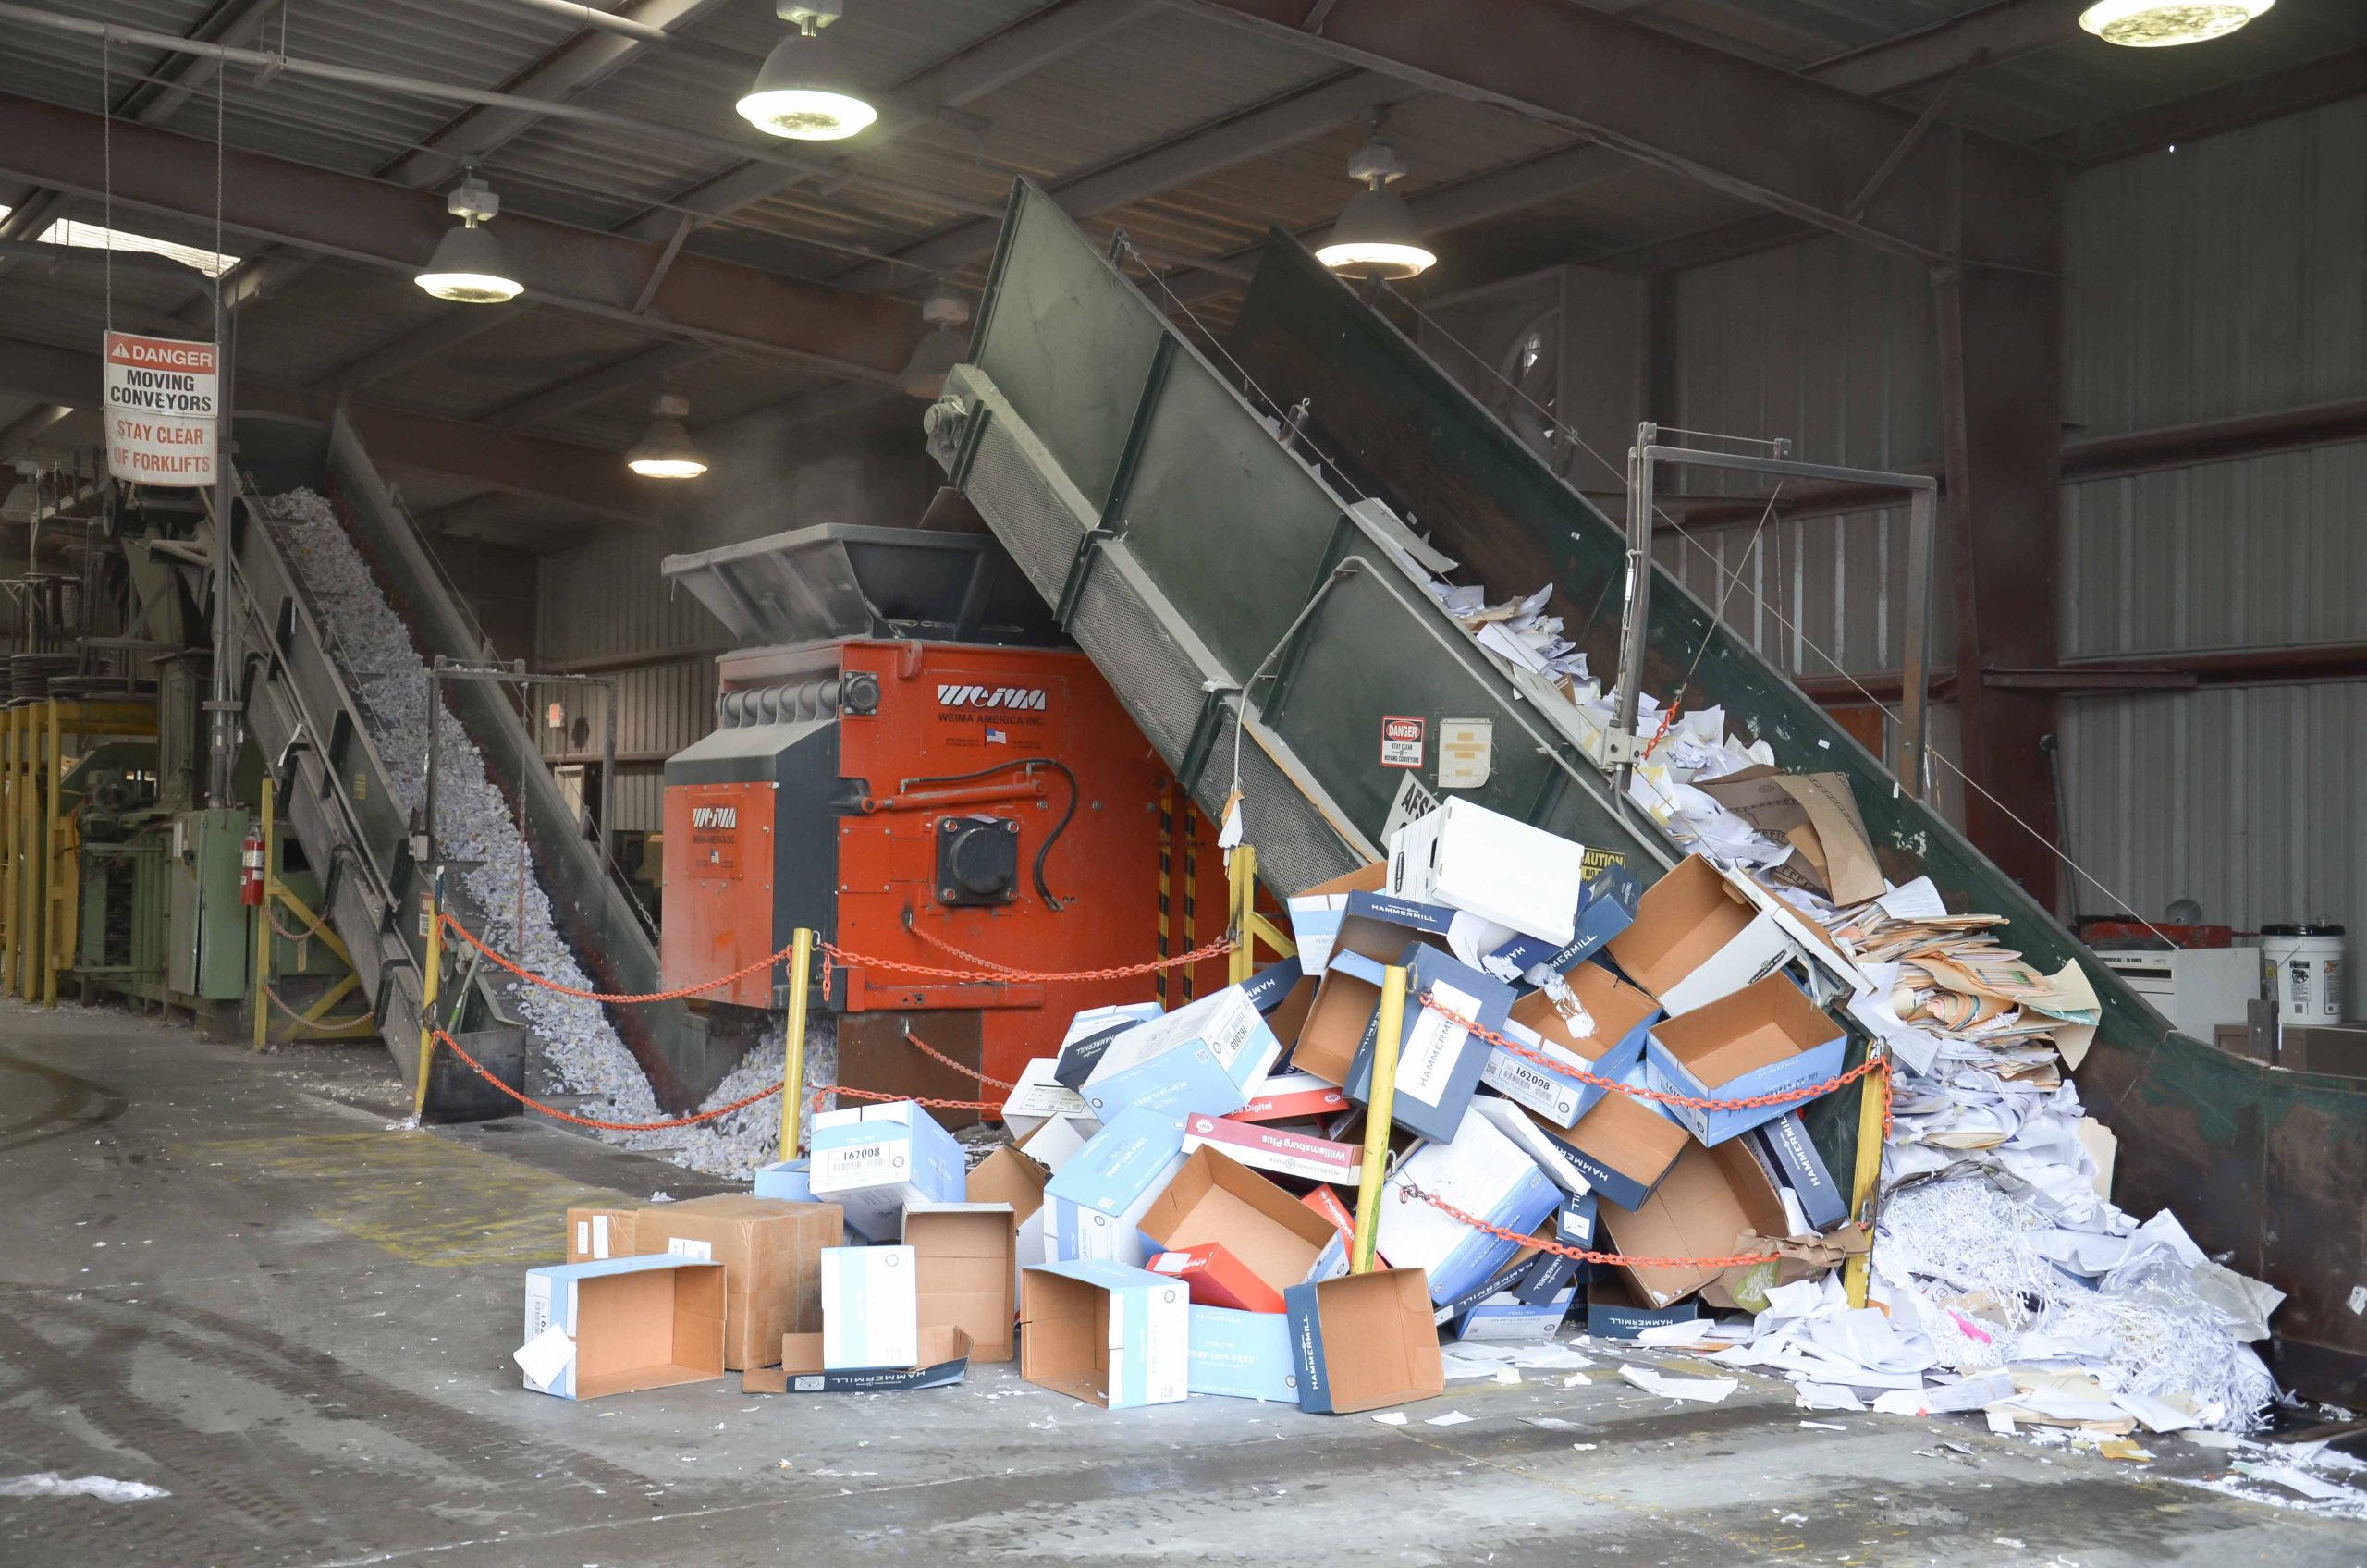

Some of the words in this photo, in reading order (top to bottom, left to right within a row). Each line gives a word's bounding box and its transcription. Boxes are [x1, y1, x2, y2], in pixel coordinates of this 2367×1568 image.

[132, 345, 213, 368] DANGER
[127, 369, 194, 392] MOVING
[110, 386, 212, 412] CONVEYORS
[117, 420, 152, 443] STAY
[156, 426, 204, 445] CLEAR
[114, 447, 129, 465] OF
[132, 451, 211, 472] FORKLIFTS
[938, 713, 973, 723] WEIMA
[976, 714, 1024, 726] AMERICA
[1388, 724, 1417, 738] DANGER
[1582, 851, 1624, 868] AUTION
[1371, 903, 1438, 923] HAMMERMILL
[1548, 933, 1598, 969] MERMILL
[1230, 1026, 1248, 1051] 162008
[1358, 1008, 1381, 1059] ERMILL
[1418, 1020, 1453, 1087] HAMMERMI
[1515, 1066, 1551, 1091] 162008
[1245, 1101, 1272, 1115] Digital
[1262, 1134, 1282, 1147] Plus
[1283, 1138, 1346, 1161] Williamsburg
[843, 1147, 880, 1161] 162008
[1457, 1261, 1534, 1305] HAMMERMILL
[1533, 1254, 1564, 1292] HAMMERMILL
[1608, 1317, 1674, 1326] HAMMERMILL
[1303, 1312, 1318, 1390] HAMMERMILL
[830, 1370, 926, 1384] HAMMERMILL
